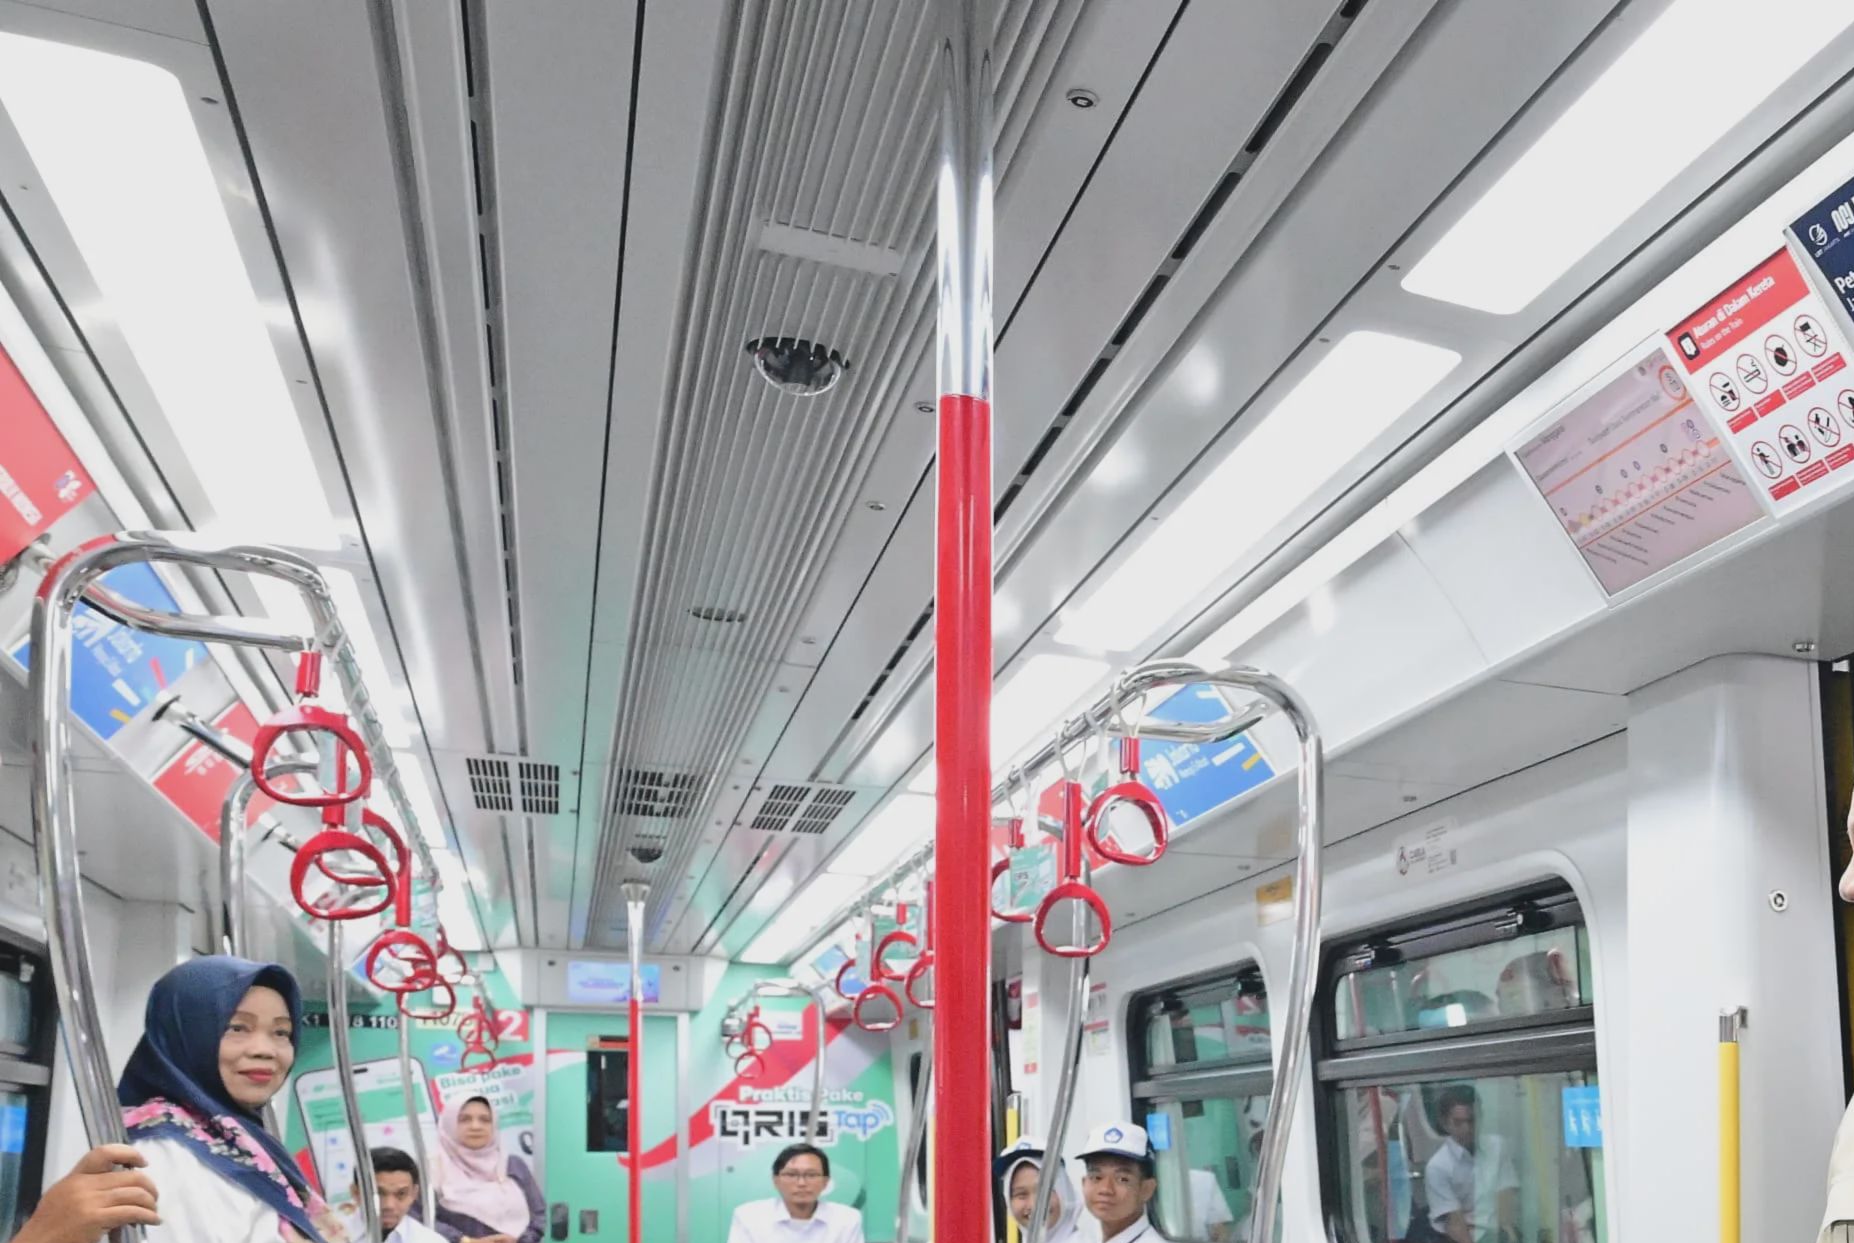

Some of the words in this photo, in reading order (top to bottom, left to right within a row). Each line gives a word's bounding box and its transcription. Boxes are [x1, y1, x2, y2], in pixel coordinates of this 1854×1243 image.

[496, 1009, 522, 1040] 2
[739, 1086, 810, 1103] Praktis
[720, 1110, 828, 1145] QRIS
[836, 1110, 881, 1136] Tap
